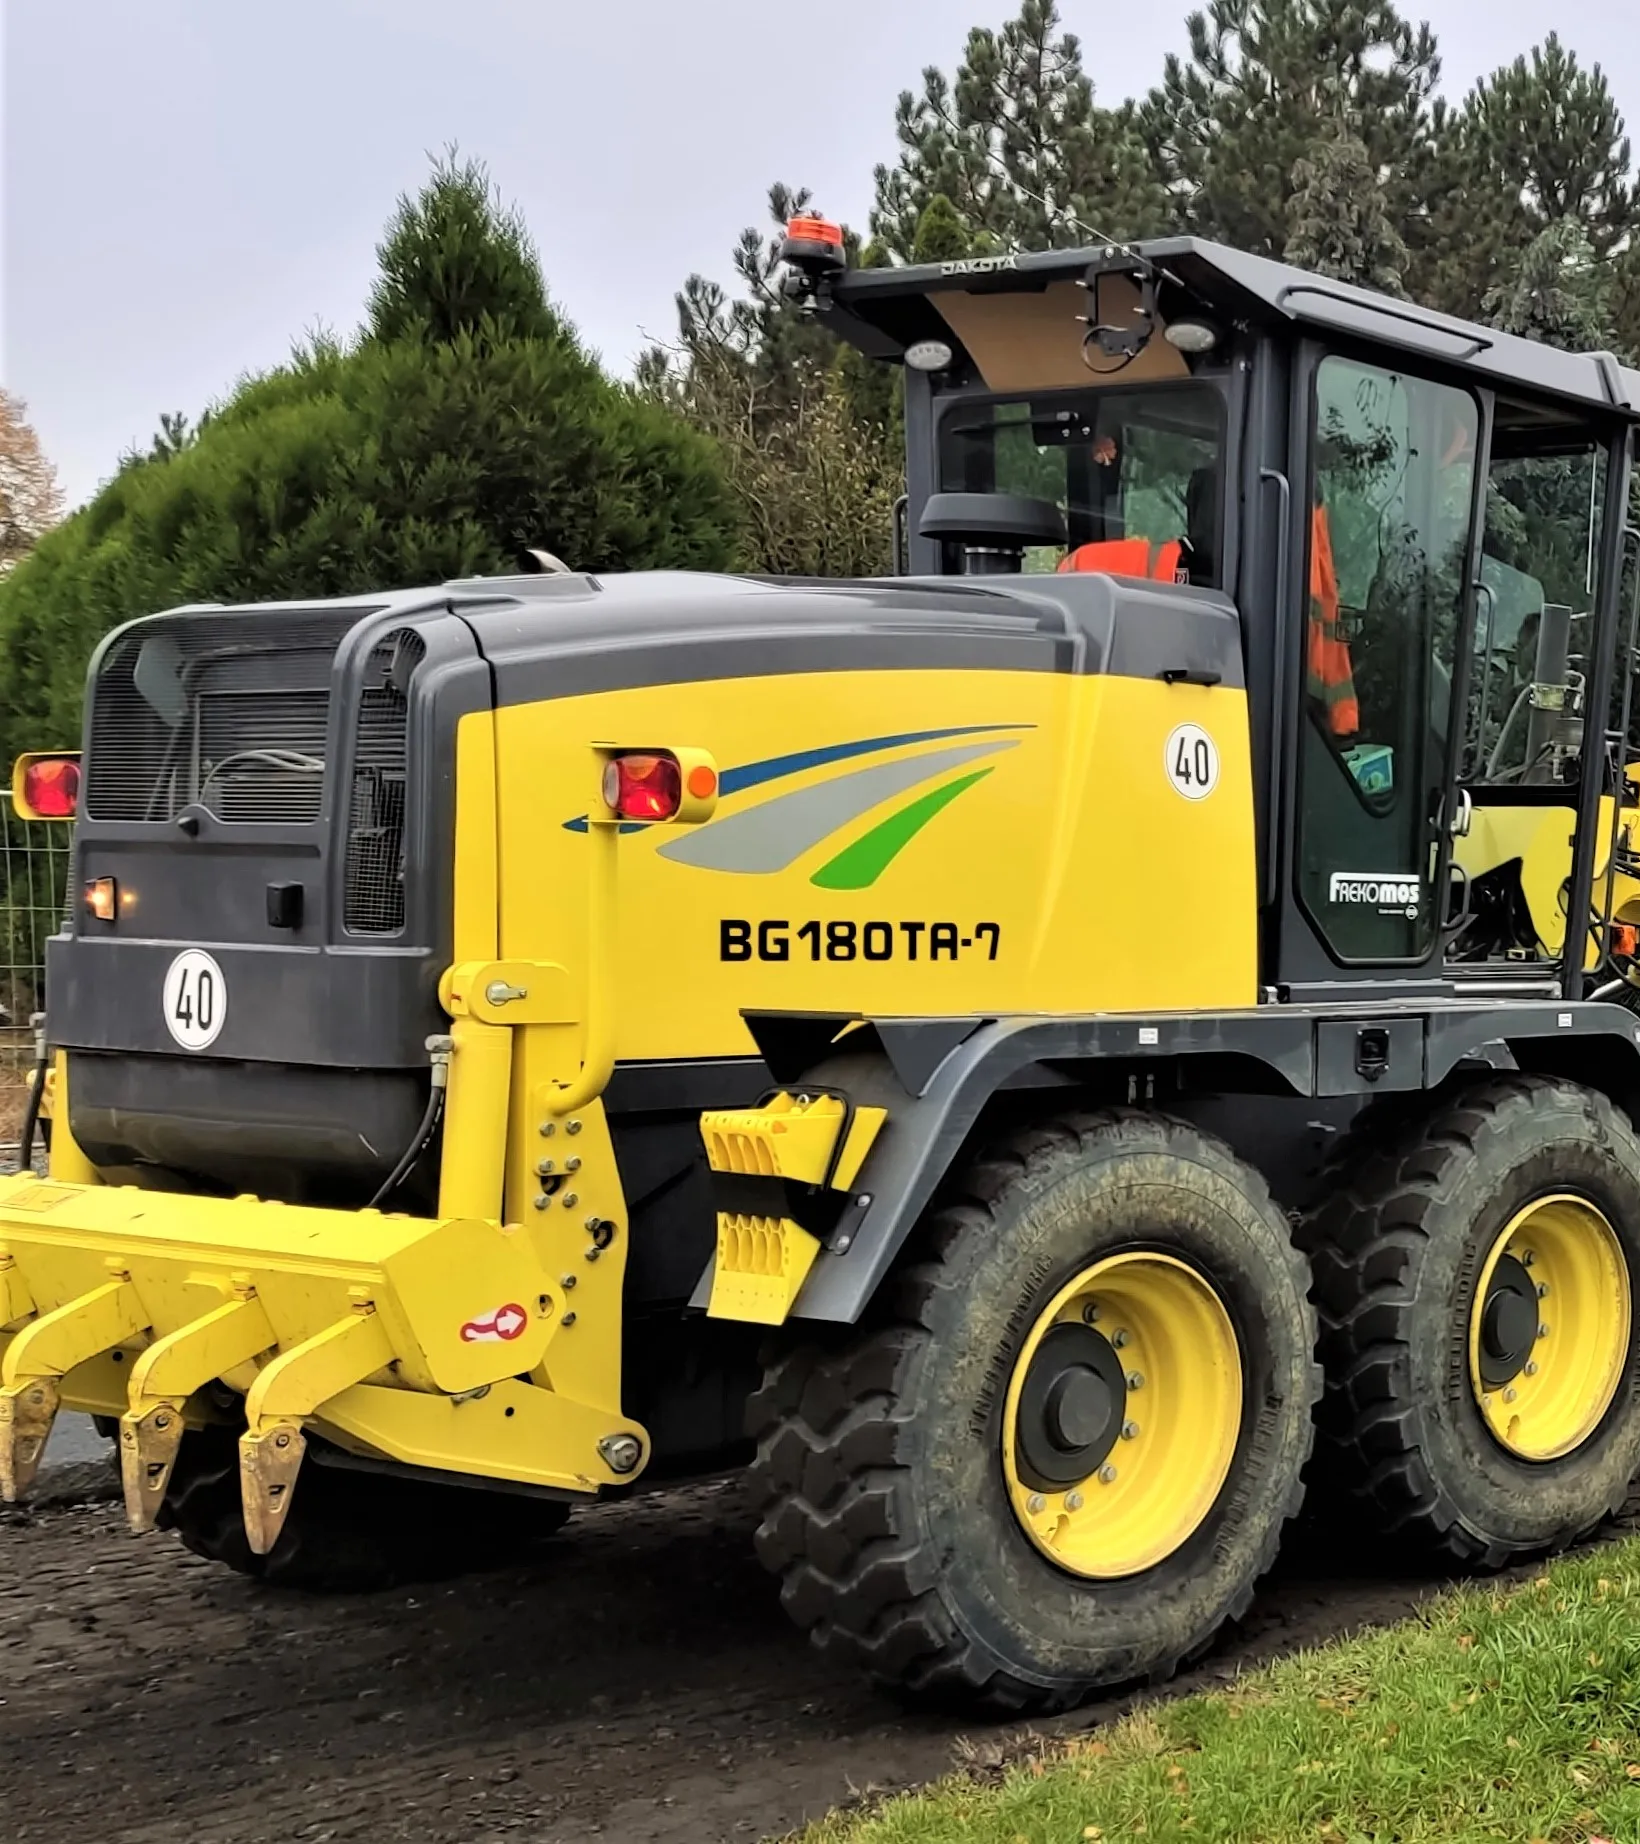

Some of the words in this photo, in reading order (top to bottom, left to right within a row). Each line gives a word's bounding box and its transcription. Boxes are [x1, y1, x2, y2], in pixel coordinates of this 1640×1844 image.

[1175, 736, 1209, 786] 40
[719, 919, 1001, 962] BG180TA-7
[175, 968, 213, 1031] 40
